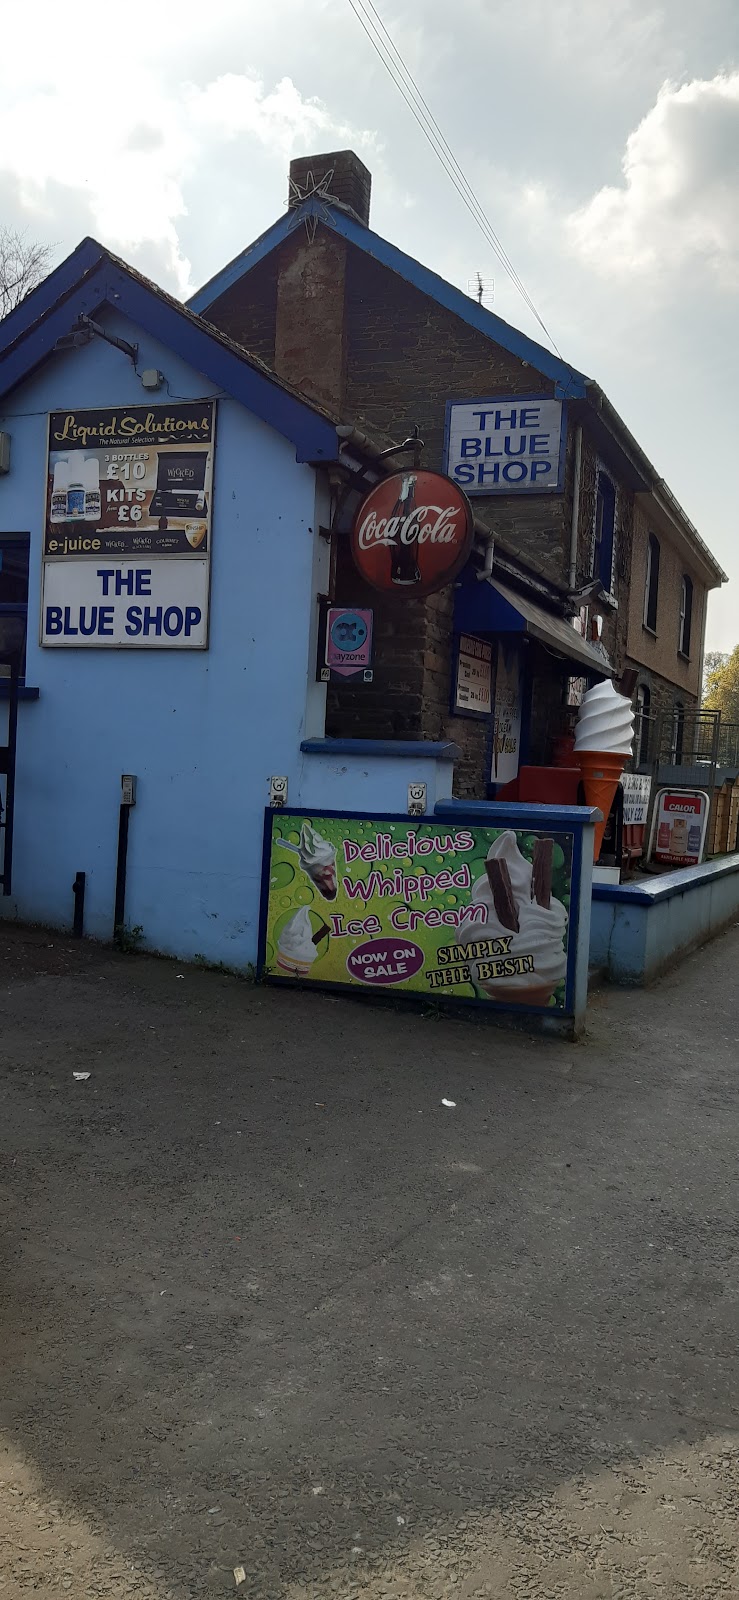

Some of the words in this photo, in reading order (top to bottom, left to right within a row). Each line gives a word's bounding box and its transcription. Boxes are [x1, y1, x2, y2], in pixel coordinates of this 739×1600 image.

[54, 415, 117, 445] Liquid
[117, 413, 209, 436] Solutions
[473, 408, 540, 430] THE
[110, 437, 130, 445] Natural
[131, 436, 155, 444] Selection
[461, 434, 550, 457] BLUE
[112, 452, 150, 461] BOTTLES
[106, 462, 146, 480] £10
[167, 468, 195, 478] WICKED
[453, 461, 552, 484] SHOP
[106, 488, 147, 503] KITS
[118, 505, 143, 521] £6
[358, 505, 461, 550] Coca-Cola
[48, 536, 101, 554] e-juice
[97, 569, 152, 596] THE
[45, 606, 115, 635] BLUE
[125, 605, 202, 636] SHOP
[334, 653, 366, 663] ayzone
[669, 803, 696, 814] CALOR
[342, 831, 474, 863] Delicious
[342, 863, 471, 902] Whipped
[330, 914, 381, 938] Ice
[391, 902, 488, 932] Cream
[351, 951, 388, 966] NOW
[393, 947, 416, 959] ON
[437, 936, 513, 965] SIMPLY
[364, 962, 408, 979] SALE
[426, 968, 470, 988] THE
[477, 955, 535, 980] BEST!
